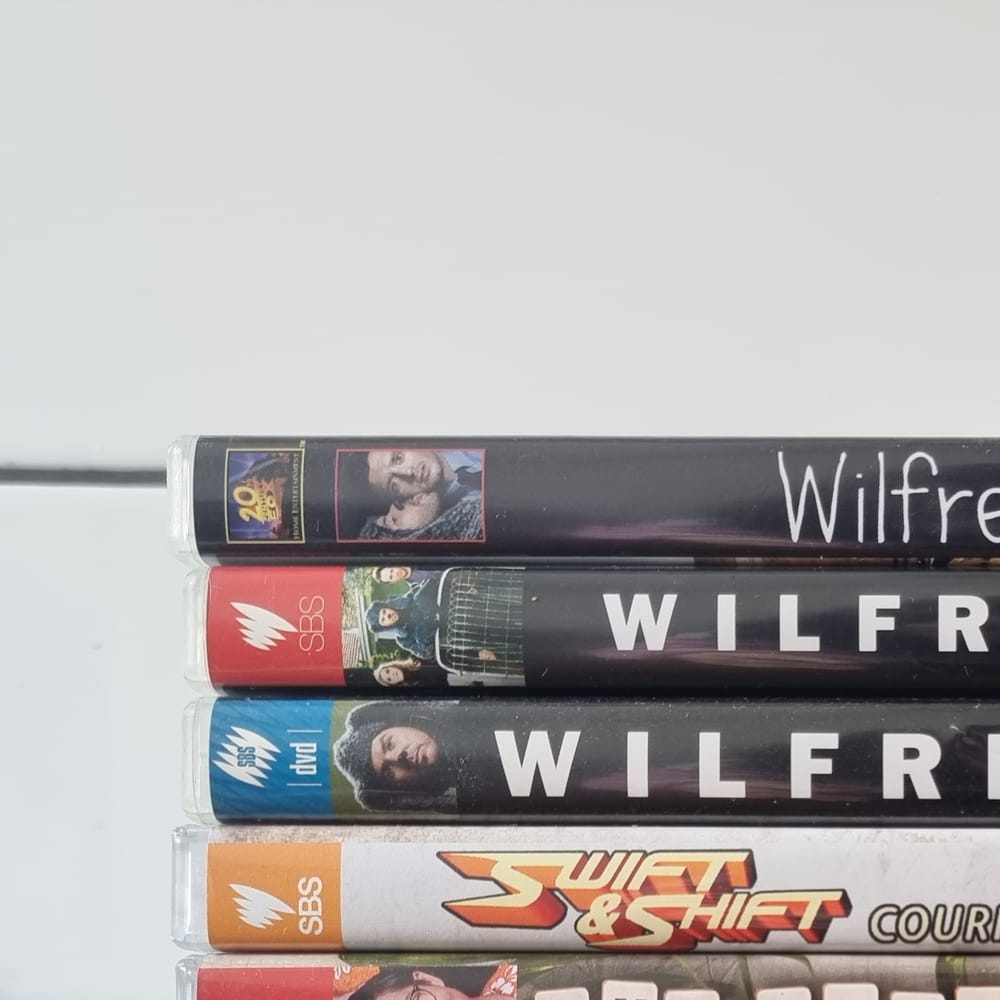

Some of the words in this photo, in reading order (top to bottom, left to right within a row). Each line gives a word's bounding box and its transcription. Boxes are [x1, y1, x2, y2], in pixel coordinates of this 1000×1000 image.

[233, 486, 265, 524] 20
[299, 595, 325, 653] SBS
[236, 746, 257, 768] SBS
[289, 742, 318, 775] dvd
[297, 876, 324, 936] SBS
[437, 849, 757, 929] SWIFT
[577, 894, 624, 938] &
[587, 889, 852, 950] SHIFT
